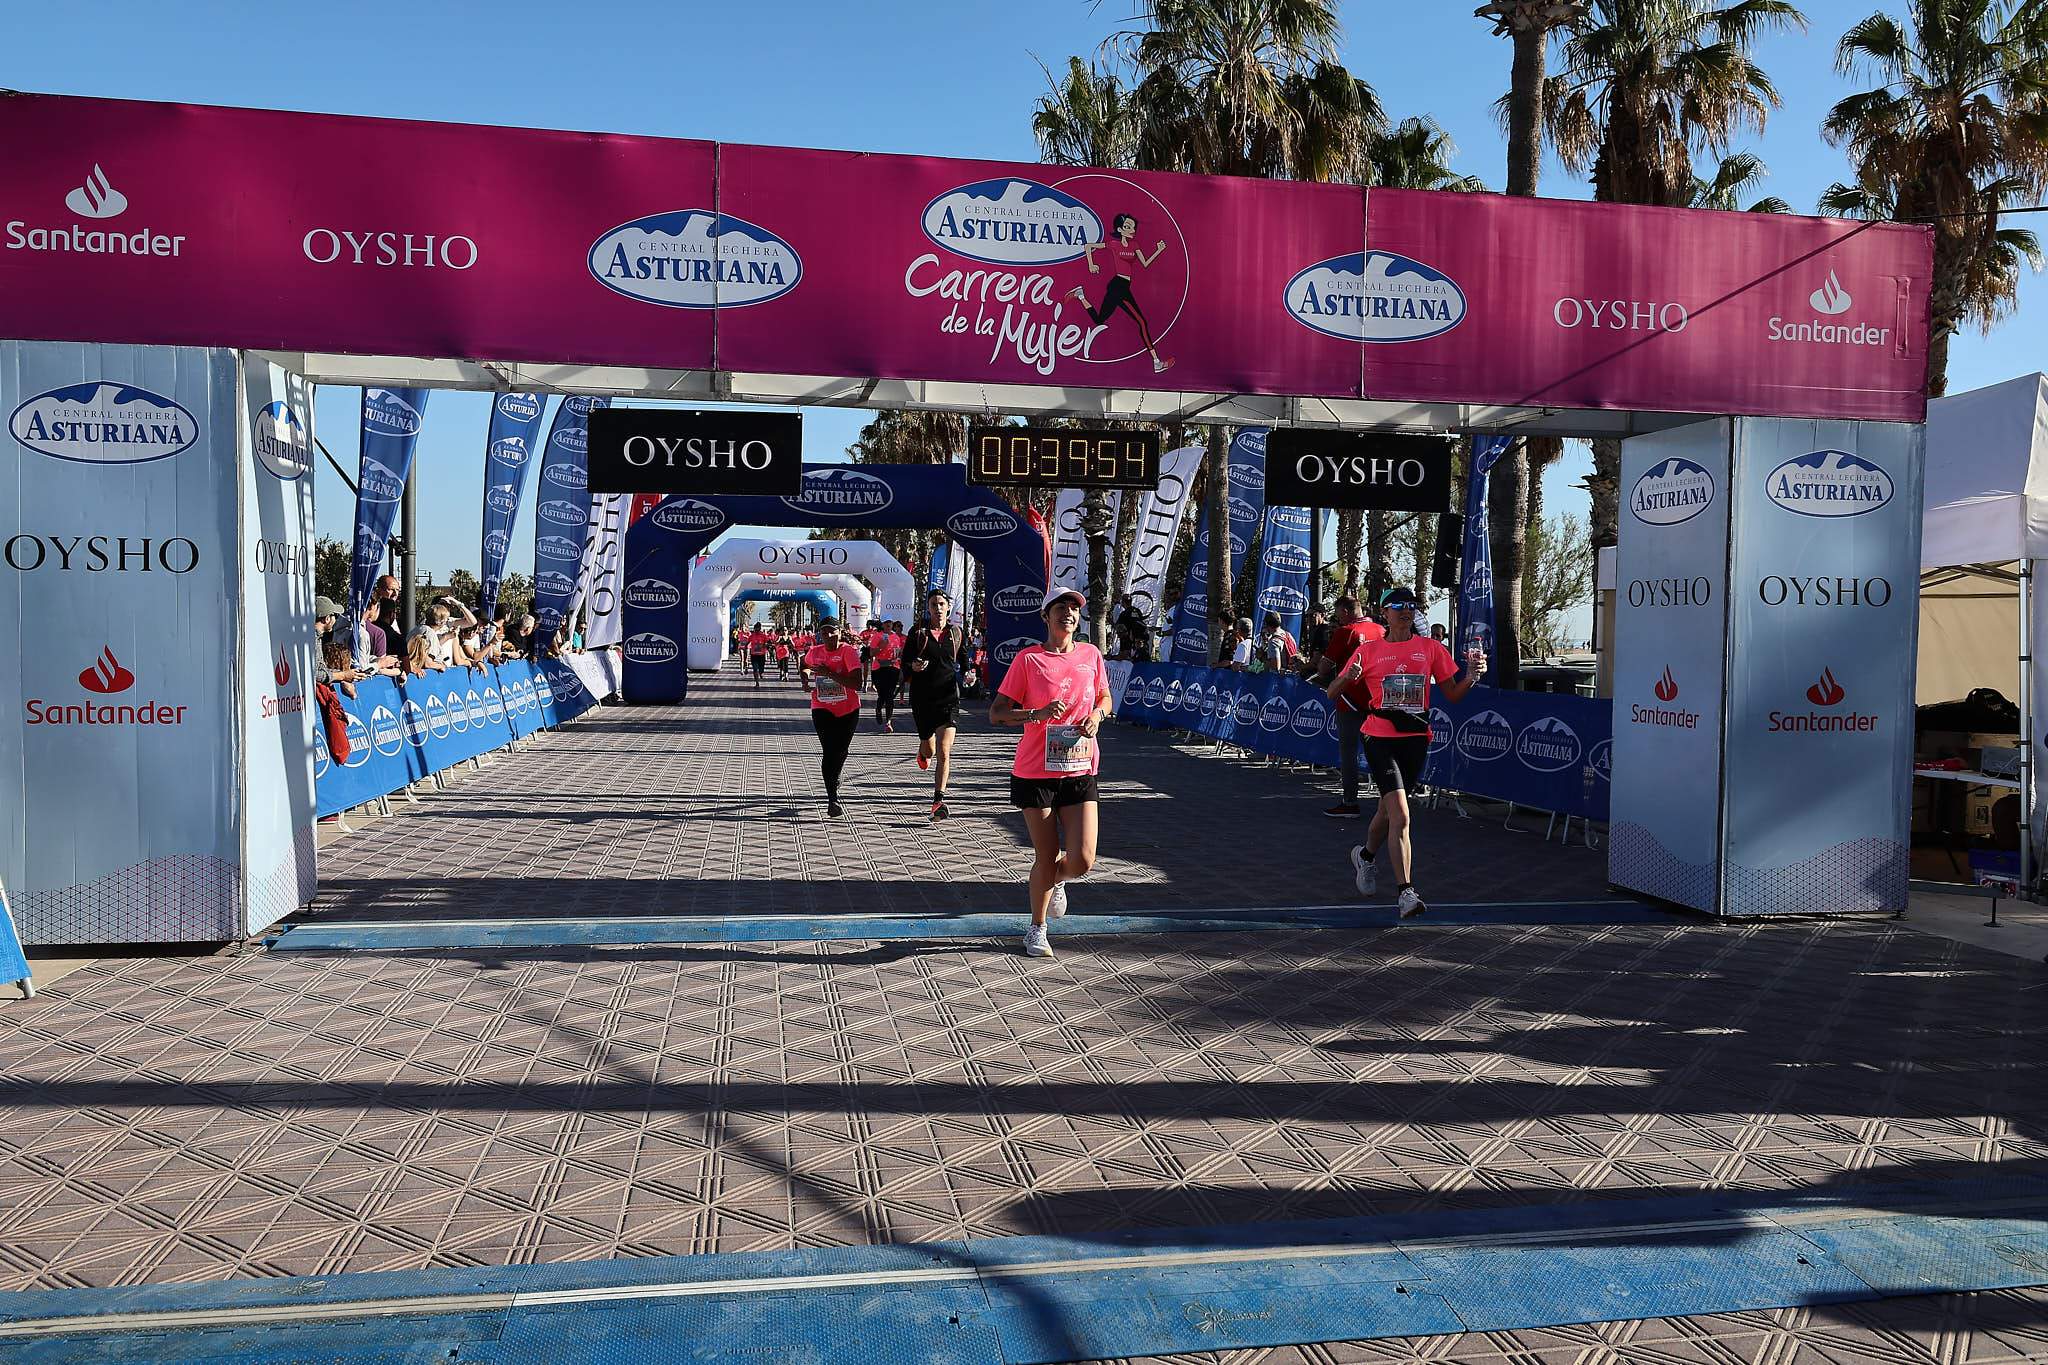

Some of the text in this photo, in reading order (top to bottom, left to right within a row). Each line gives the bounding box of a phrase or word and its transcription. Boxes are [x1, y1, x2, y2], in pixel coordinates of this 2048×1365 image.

[936, 205, 1089, 246] ASTURIANA
[964, 204, 1085, 221] CENTRAL LECHERA
[6, 220, 186, 257] Santander
[302, 228, 479, 270] OYSHO
[638, 241, 780, 257] CENTRAL LECHERA
[605, 242, 786, 285] ASTURIANA
[905, 253, 1055, 305] Carrera
[1327, 280, 1447, 295] CENTRAL LECHERA
[1298, 281, 1453, 321] ASTURIANA
[1553, 298, 1689, 333] OYSHO
[941, 303, 1109, 375] de la Mujer
[1768, 317, 1890, 346] Santander
[24, 410, 185, 445] ASTURIANA
[53, 408, 179, 421] CENTRAL LECHERA
[258, 423, 307, 466] ASTURIANA
[623, 436, 772, 470] OYSHO
[981, 436, 1145, 478] 00:39:54
[1296, 454, 1425, 487] OYSHO
[1795, 472, 1881, 482] CENTRAL LECHERA
[1635, 486, 1708, 512] ASTURIANA
[1774, 474, 1883, 501] ASTURIANA
[656, 511, 719, 525] ASTURIANA
[952, 519, 1013, 531] ASTURIANA
[4, 534, 200, 574] OYSHO
[256, 538, 309, 577] OYSHO
[758, 545, 848, 566] OYSHO
[1266, 552, 1311, 568] ASTURIAN
[705, 565, 733, 573] OYSHO
[872, 566, 899, 574] OYSHO
[627, 590, 676, 602] ASTURIANA
[1628, 576, 1711, 608] OYSHO
[1759, 575, 1892, 607] OYSHO
[625, 643, 674, 656] ASTURIANA
[26, 699, 187, 725] Santander
[261, 693, 305, 719] Santander
[1632, 703, 1699, 729] Santander
[1768, 711, 1878, 732] Santander
[1459, 727, 1507, 751] ASTURIANA
[1519, 734, 1573, 762] ASTURIANA
